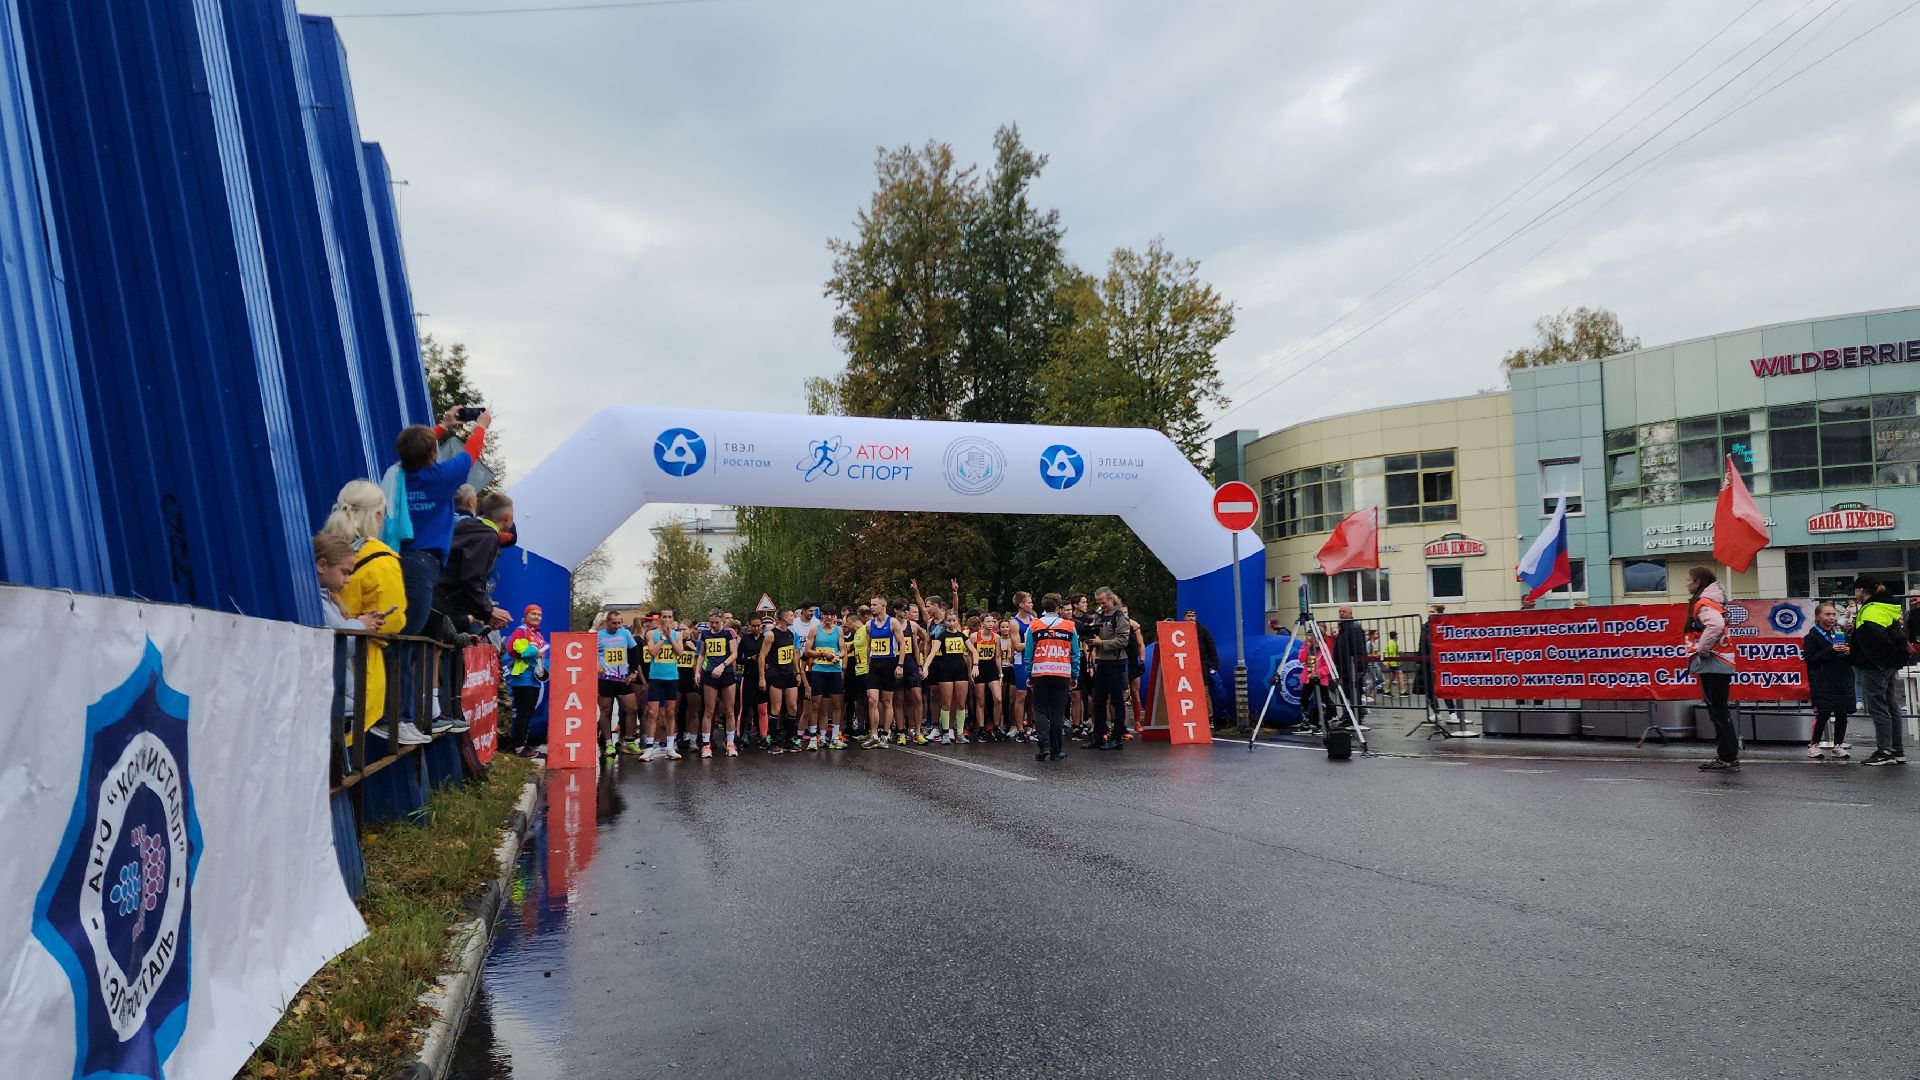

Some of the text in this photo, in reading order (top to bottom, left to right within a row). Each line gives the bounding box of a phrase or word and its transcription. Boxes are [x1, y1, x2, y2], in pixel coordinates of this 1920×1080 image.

[1750, 340, 1920, 378] WILDBERRIE
[723, 442, 755, 453] ТВЭЛ
[856, 445, 909, 460] АТОМ
[723, 458, 771, 468] РОСАТОМ
[1097, 457, 1144, 467] ЭЛЕМАШ
[847, 464, 913, 481] СПОРТ
[1097, 472, 1138, 480] РОСАТОМ
[1809, 511, 1893, 530] ПАПА ДЖОНС
[1603, 616, 1669, 636] пробег
[1729, 627, 1758, 636] МАШ
[708, 641, 722, 652] 216
[874, 641, 887, 652] 315
[949, 640, 962, 651] 212
[607, 650, 623, 663] 338
[658, 648, 674, 659] 202
[1440, 650, 1492, 663] памяти
[1495, 647, 1542, 664] Героя
[1546, 644, 1688, 662] Социалистичес
[1171, 629, 1197, 740] СТАРТ
[1440, 671, 1520, 686] Почетного
[1522, 672, 1585, 686] жителя
[1588, 672, 1651, 688] города
[1655, 668, 1697, 685] С.И.
[564, 641, 583, 762] СТАРТ
[88, 818, 112, 894] АНО
